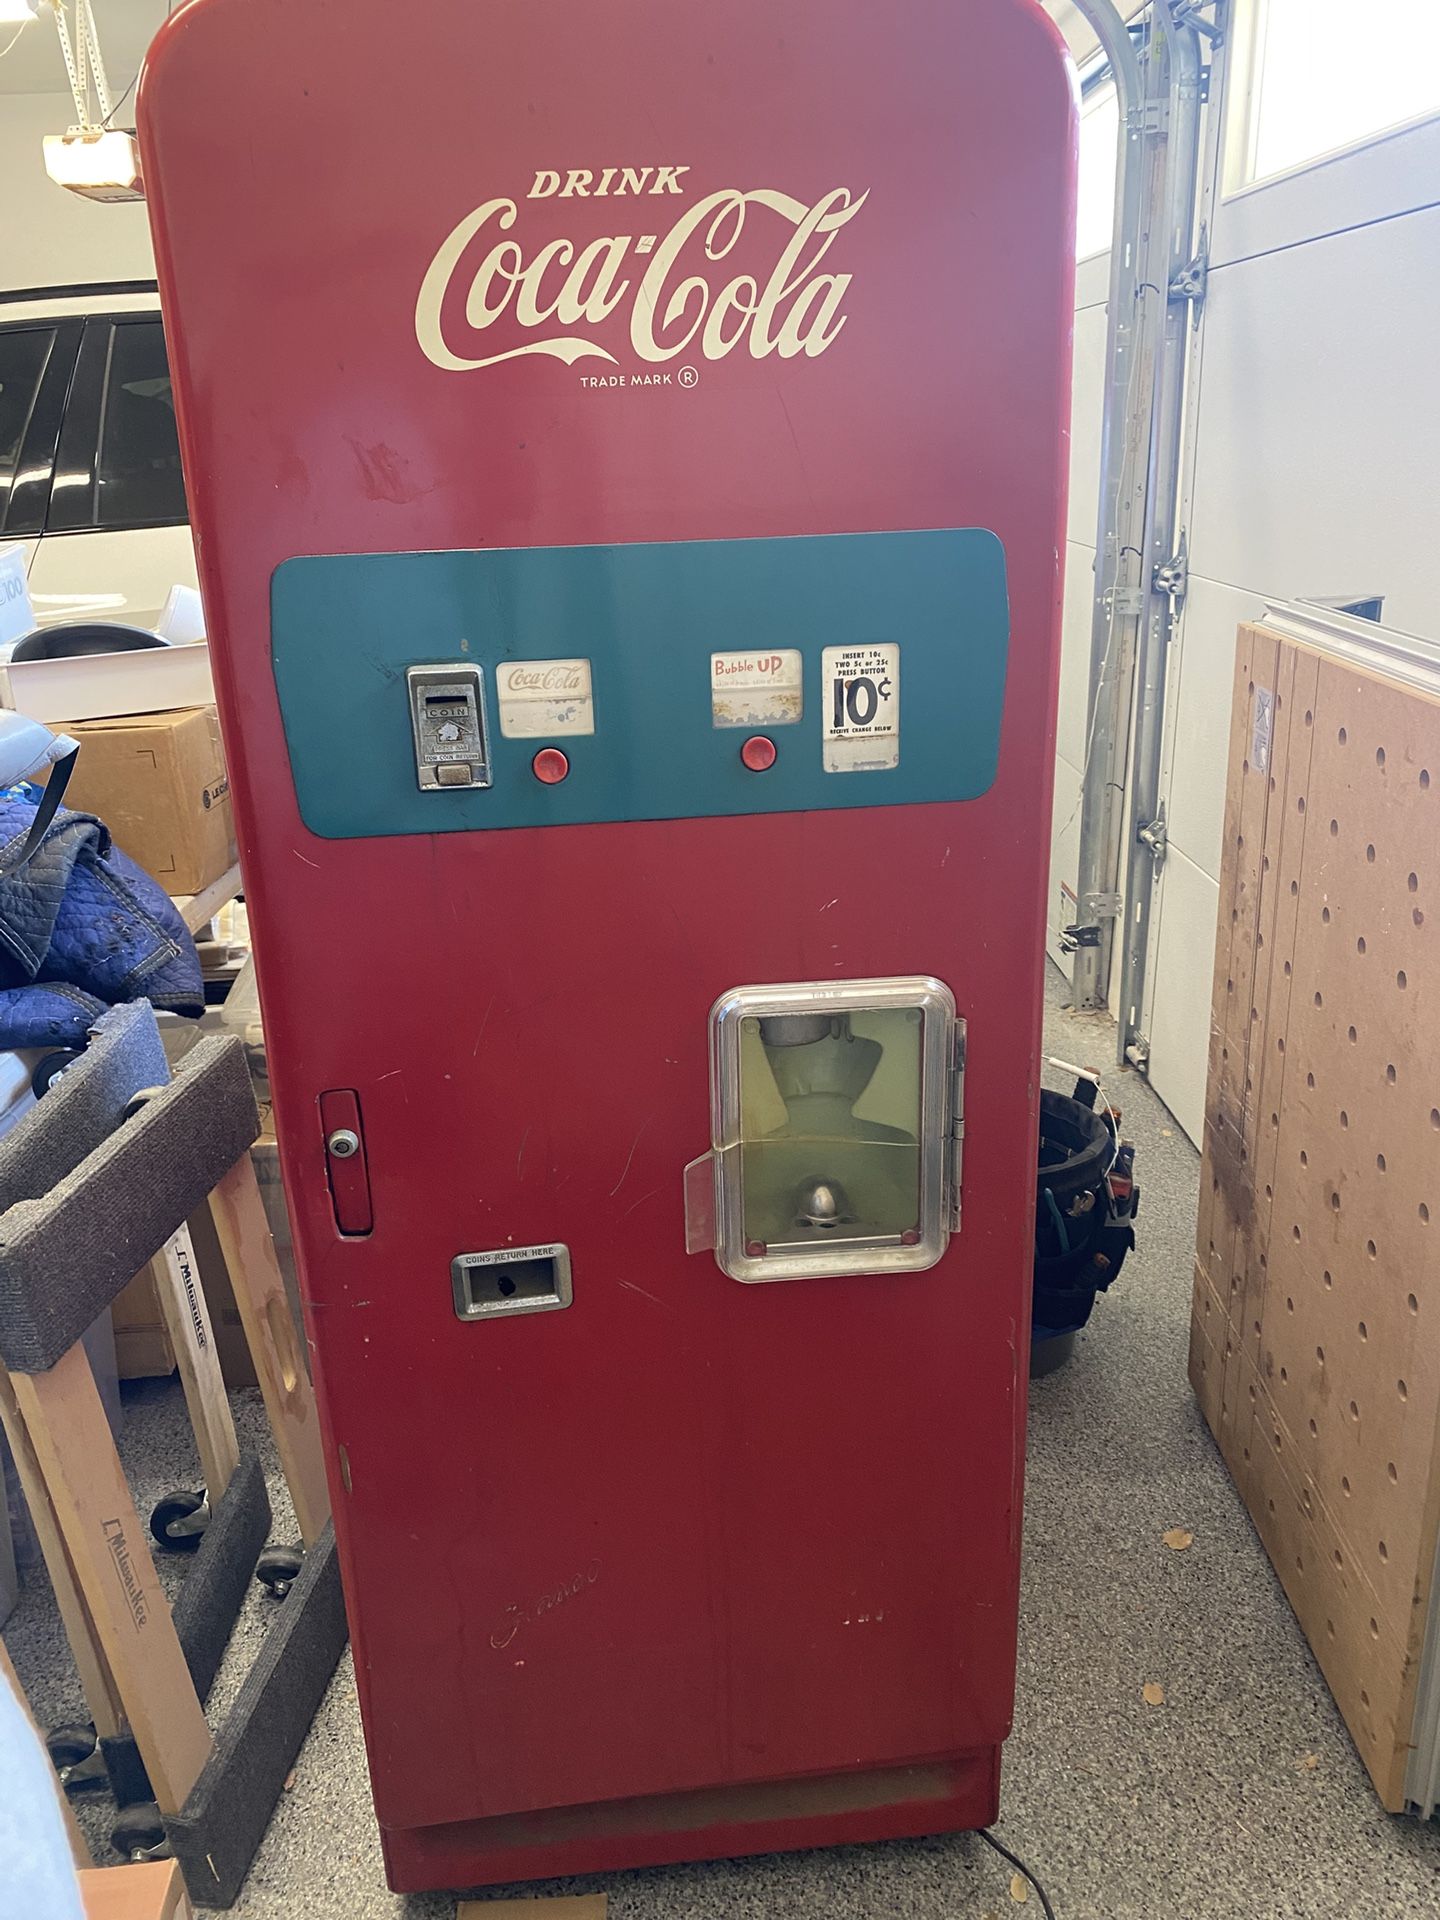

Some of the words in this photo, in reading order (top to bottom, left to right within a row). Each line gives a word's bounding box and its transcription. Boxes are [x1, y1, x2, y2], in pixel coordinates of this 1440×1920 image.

[526, 166, 690, 198] DRINK
[415, 187, 870, 371] Coca-Cola
[580, 376, 625, 388] TRADE
[630, 374, 672, 386] MARK
[842, 652, 865, 660] INSERT
[508, 665, 583, 691] Coca-Cola
[715, 659, 754, 676] Bubble
[860, 667, 886, 675] BUTTON
[833, 676, 892, 728] 10¢
[430, 709, 465, 717] COIN
[466, 1255, 491, 1264] COINS
[494, 1250, 528, 1262] RETURN
[531, 1247, 554, 1256] HERE
[180, 1262, 207, 1349] Milwaukee
[106, 1527, 148, 1629] Milwaukee
